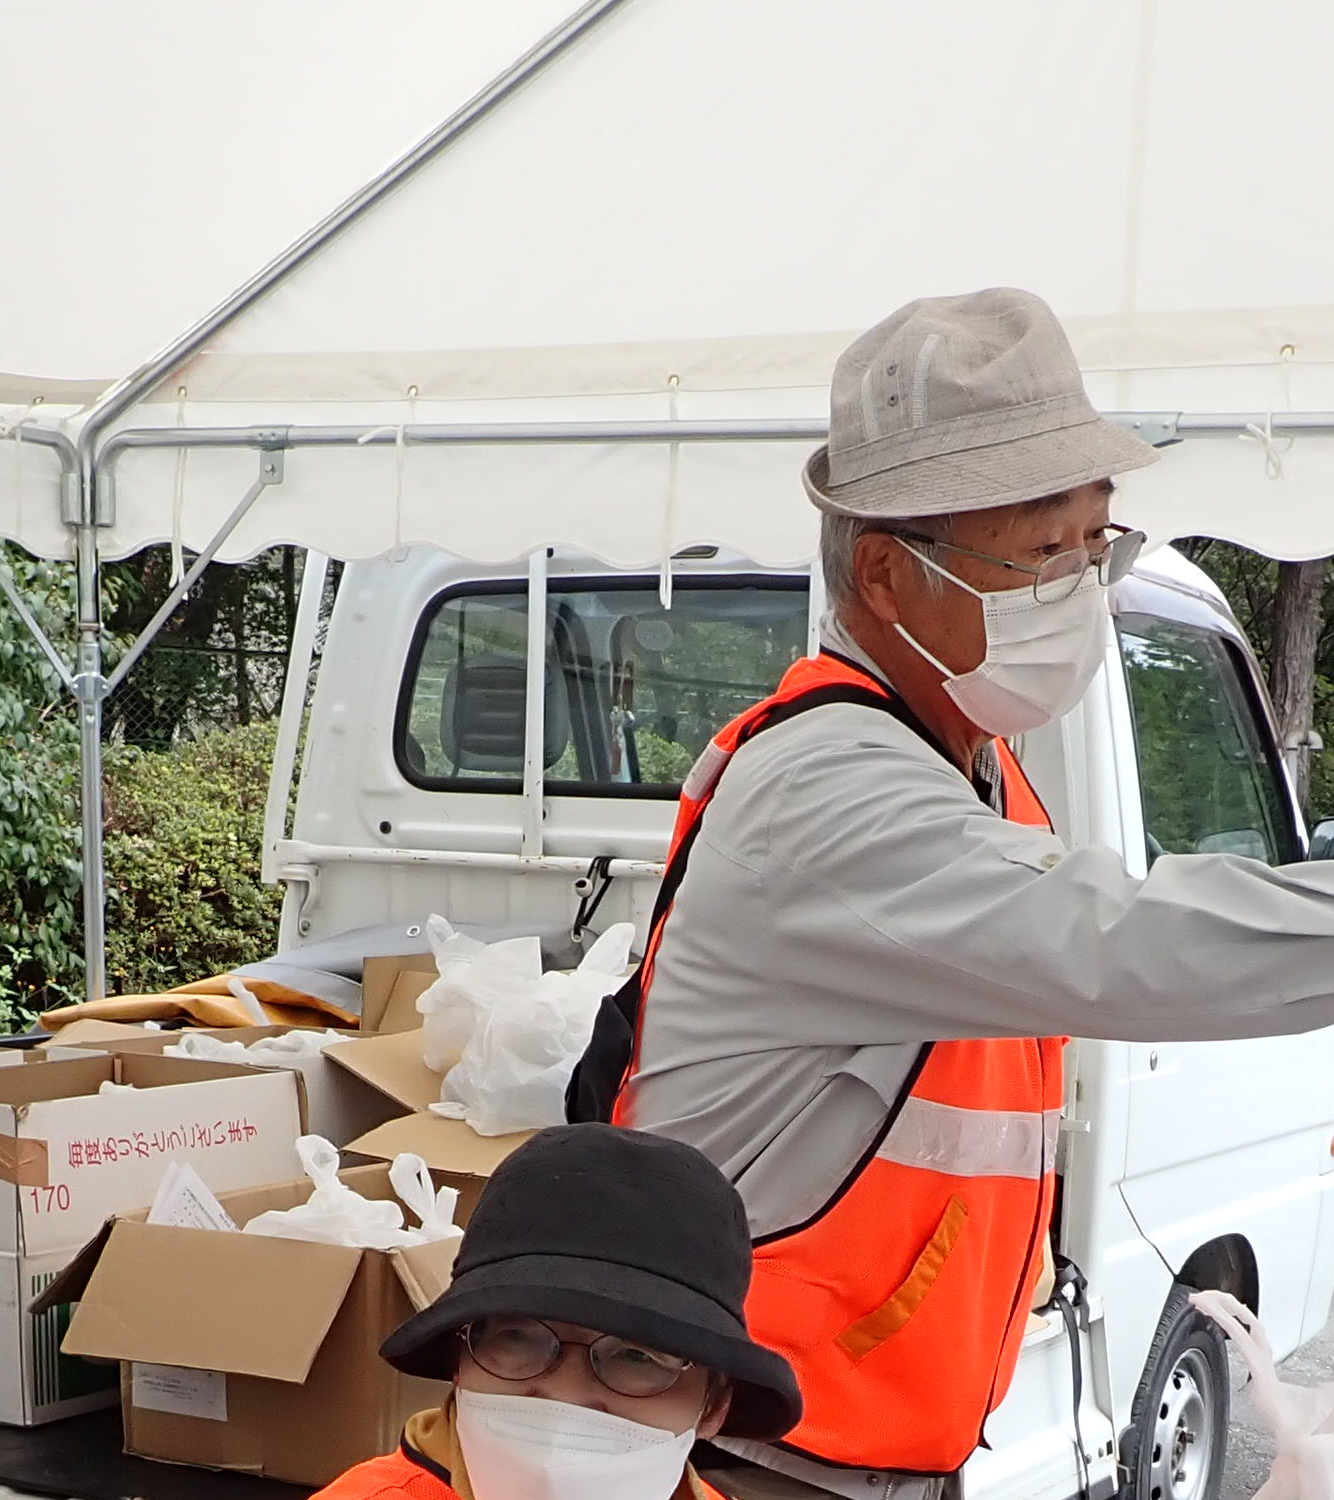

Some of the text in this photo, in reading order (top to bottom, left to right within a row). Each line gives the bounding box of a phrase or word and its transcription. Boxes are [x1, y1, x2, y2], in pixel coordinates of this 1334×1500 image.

[68, 1117, 258, 1169] 毎度ありがとうございます
[30, 1184, 71, 1214] 170
